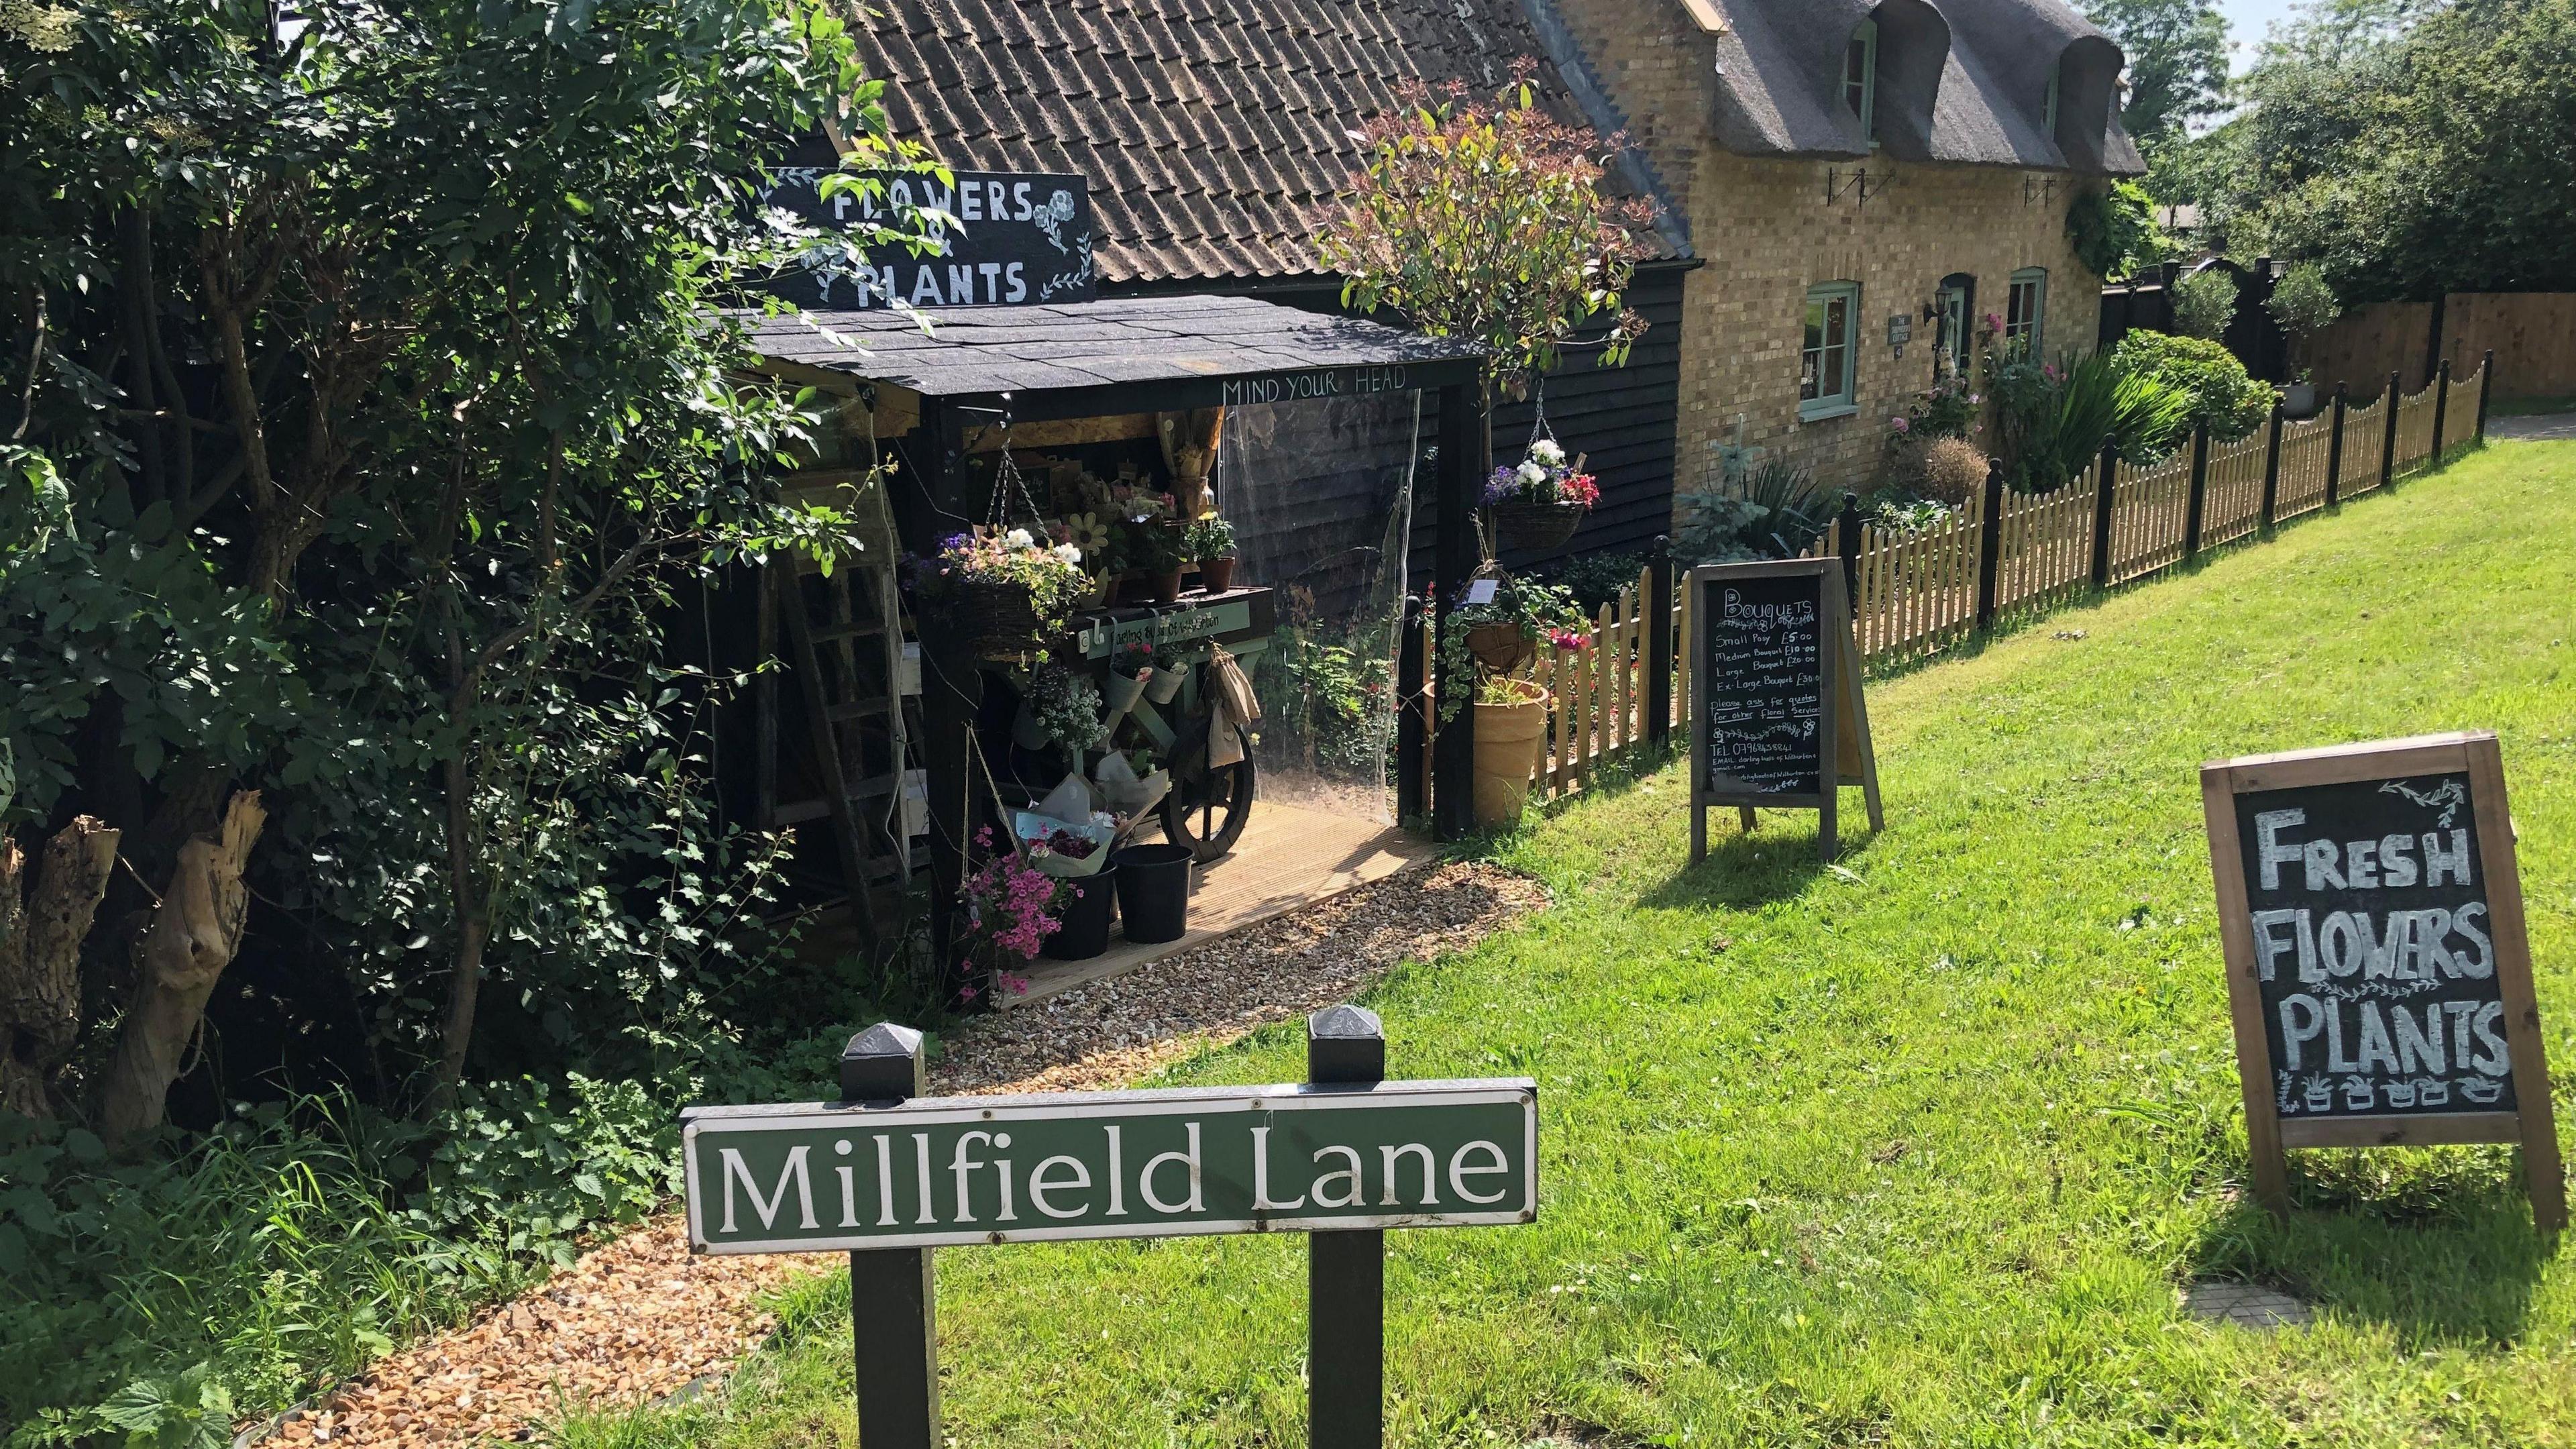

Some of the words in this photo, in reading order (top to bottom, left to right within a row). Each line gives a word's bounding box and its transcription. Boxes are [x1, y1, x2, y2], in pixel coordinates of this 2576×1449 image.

[857, 262, 1027, 308] PLANTS
[1222, 379, 1279, 406] MIND
[1286, 371, 1338, 400] YOUR
[1356, 366, 1406, 392] HEAD
[1715, 634, 1748, 647] Small
[1752, 633, 1771, 645] Posy
[1715, 652, 1752, 662] Medium
[1754, 648, 1782, 657] Bouquet
[1716, 667, 1745, 680] Large
[1753, 659, 1784, 671] Bouquet
[1764, 675, 1794, 688] Bouquet
[1746, 698, 1764, 706] ask
[1770, 697, 1784, 707] for
[1713, 712, 1727, 724] for
[1710, 743, 1730, 757] TEL
[1712, 757, 1735, 765] EMAIL
[2254, 808, 2471, 892] FRESH
[2251, 902, 2493, 983] FLOWERS
[2279, 993, 2511, 1077] PLANTS
[718, 1122, 1207, 1234] Millfield
[1250, 1126, 1509, 1211] Lane
